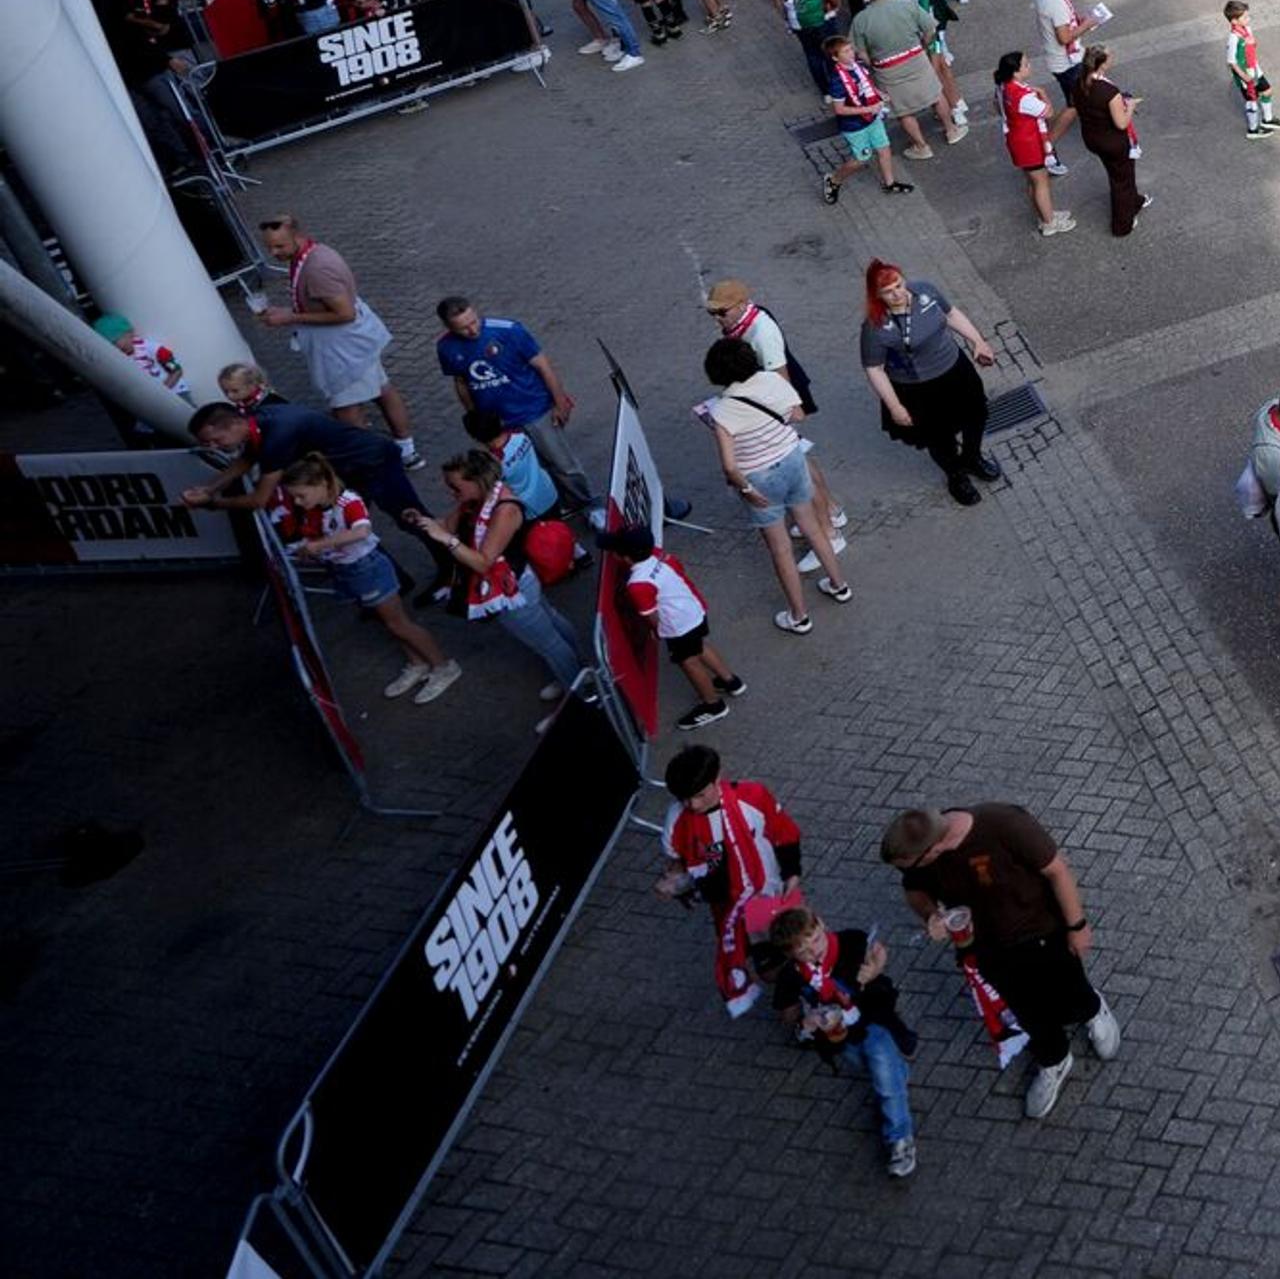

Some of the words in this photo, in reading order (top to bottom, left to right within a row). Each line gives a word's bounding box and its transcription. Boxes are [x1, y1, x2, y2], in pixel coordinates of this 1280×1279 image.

[317, 10, 416, 64] SINCE
[331, 37, 422, 87] 1908
[424, 809, 526, 993] SINCE
[449, 858, 540, 1023] 1908
